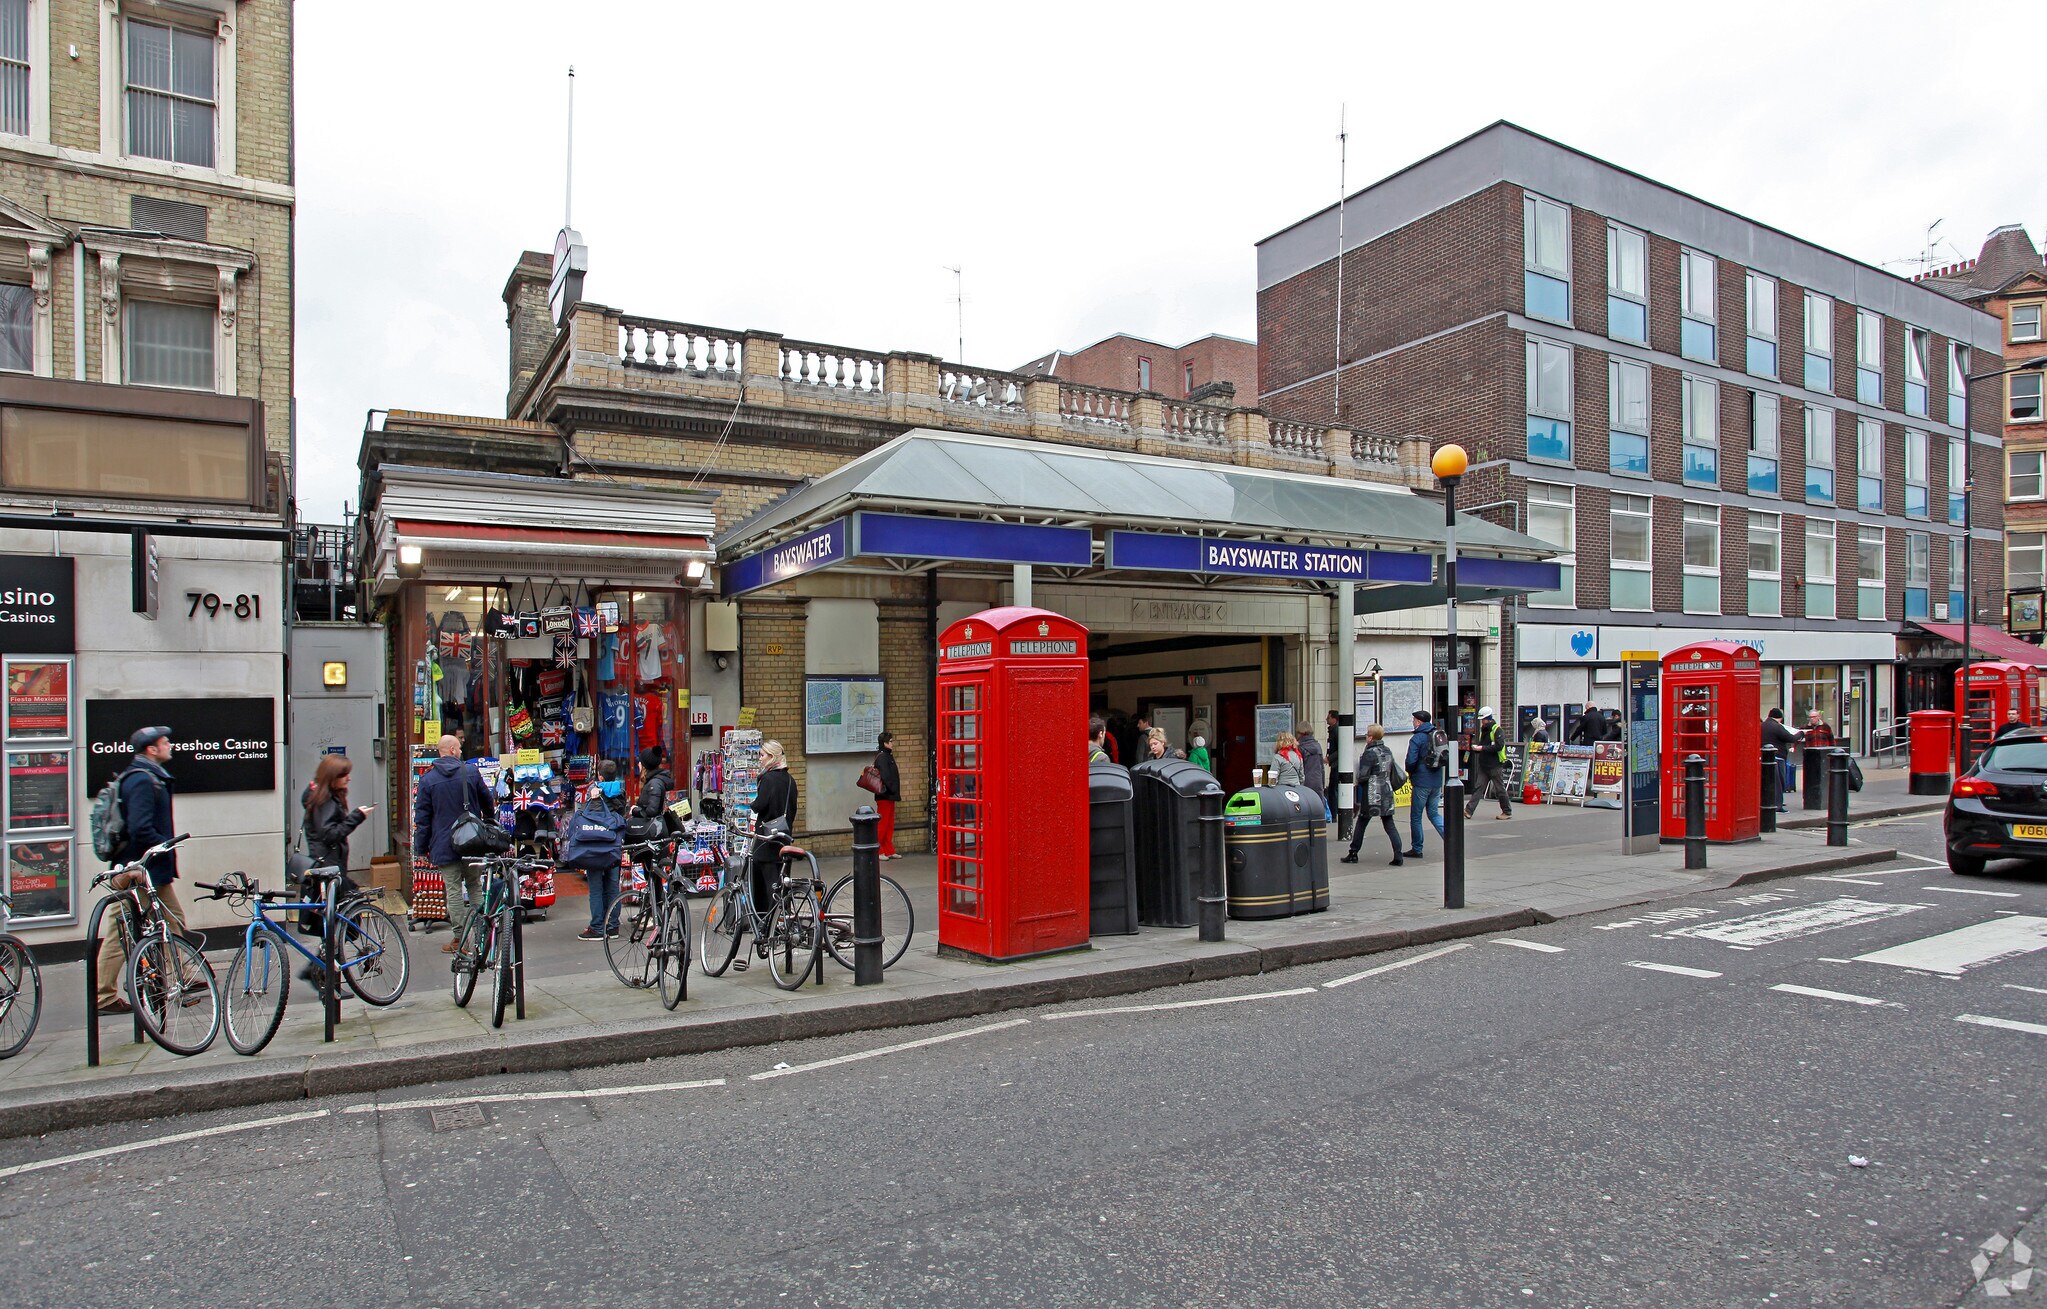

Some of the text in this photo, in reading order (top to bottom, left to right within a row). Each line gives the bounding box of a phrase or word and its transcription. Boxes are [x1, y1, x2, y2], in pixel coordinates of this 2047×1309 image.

[774, 533, 832, 573] BAYSWATER
[1209, 546, 1362, 574] BAYSWATER STATION
[0, 587, 55, 606] sino
[187, 592, 260, 619] 79-81
[1149, 601, 1211, 620] ENTRANCE
[0, 610, 56, 624] Casinos
[546, 618, 570, 632] LONDON
[767, 645, 782, 653] RVP
[948, 642, 991, 658] TELEPHONE
[1012, 641, 1075, 653] TELEPHONE
[1673, 661, 1721, 671] TELEPHNE
[615, 705, 625, 729] 9
[692, 712, 708, 723] LFB
[92, 738, 268, 754] Golde rseshoe Casino
[195, 751, 268, 761] Grosvenor Casinos
[1595, 766, 1623, 777] HERE
